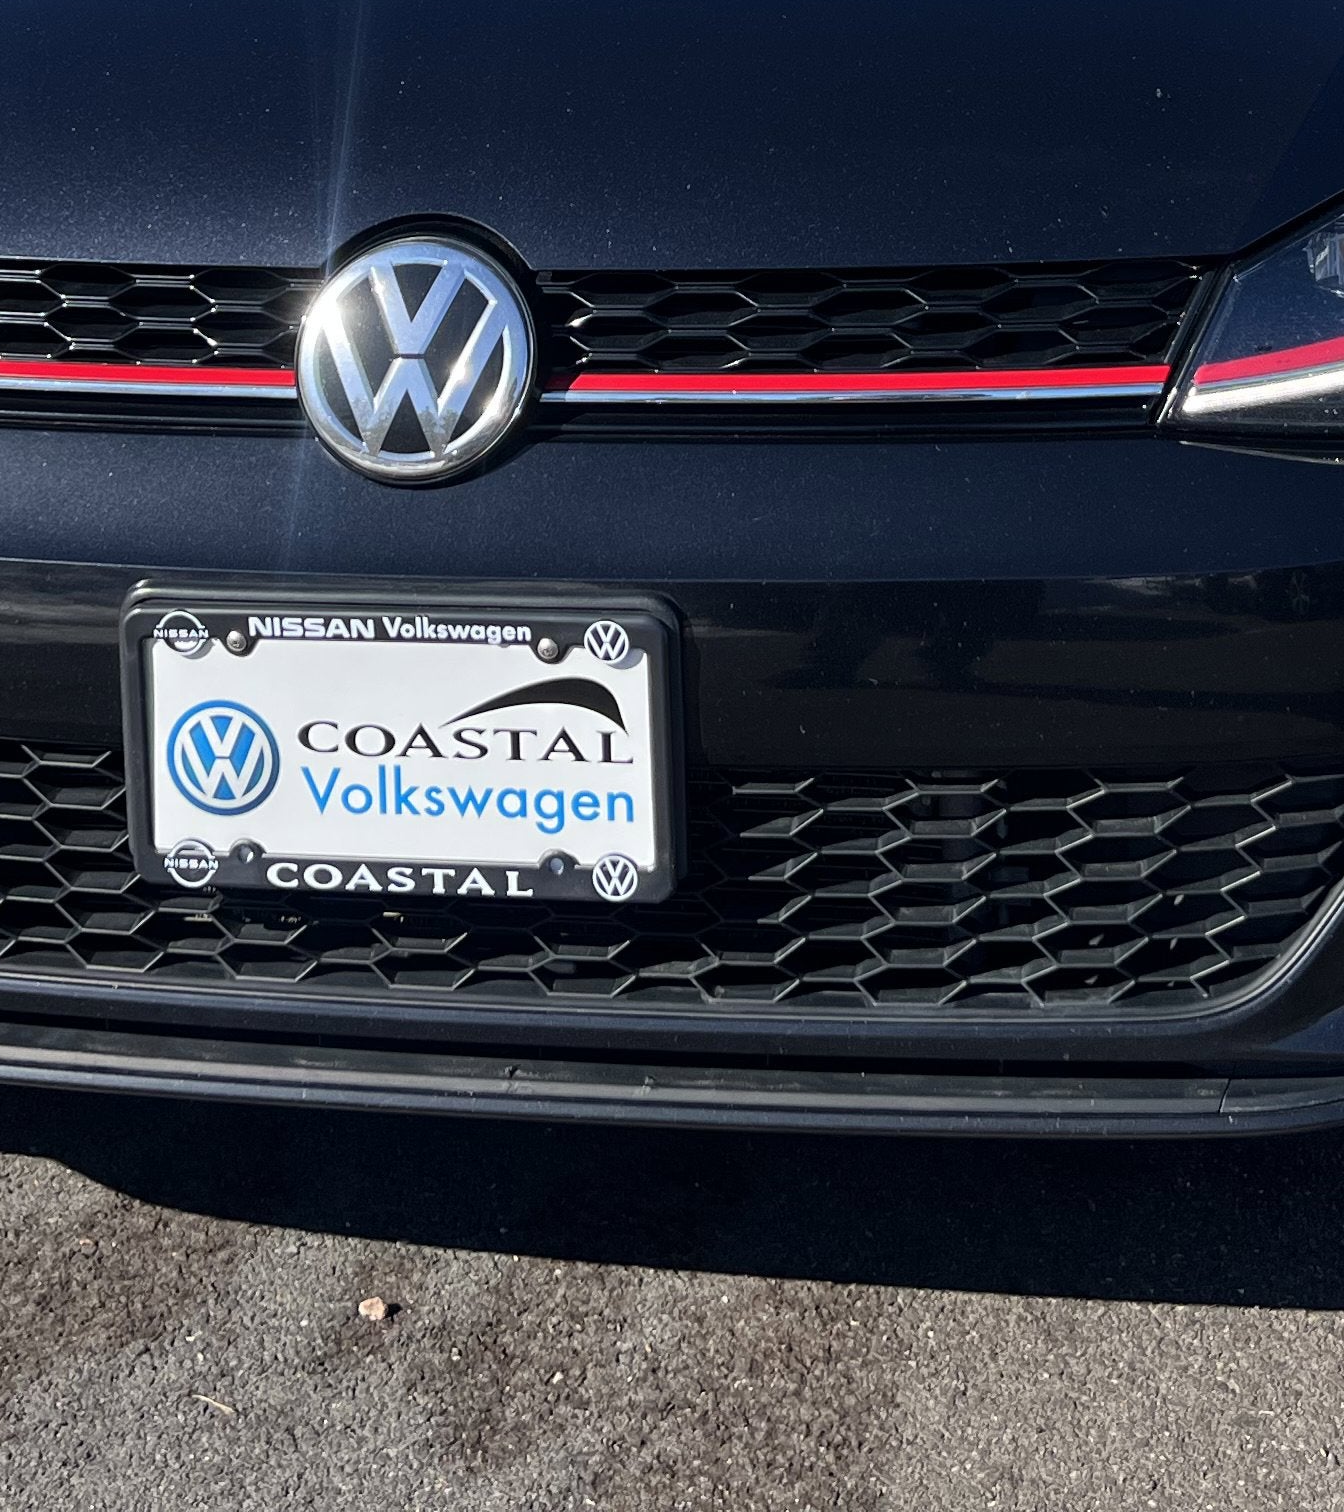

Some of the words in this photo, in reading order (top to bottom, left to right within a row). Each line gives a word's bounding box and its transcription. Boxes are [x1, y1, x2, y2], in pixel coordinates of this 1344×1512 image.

[154, 629, 209, 639] NISSAN
[248, 616, 375, 639] NISSAN
[382, 616, 532, 644] Volkswagen
[297, 721, 634, 765] COASTAL
[301, 765, 635, 834] Volkswagen
[164, 857, 218, 869] NISSAN
[266, 862, 533, 898] COASTAL
